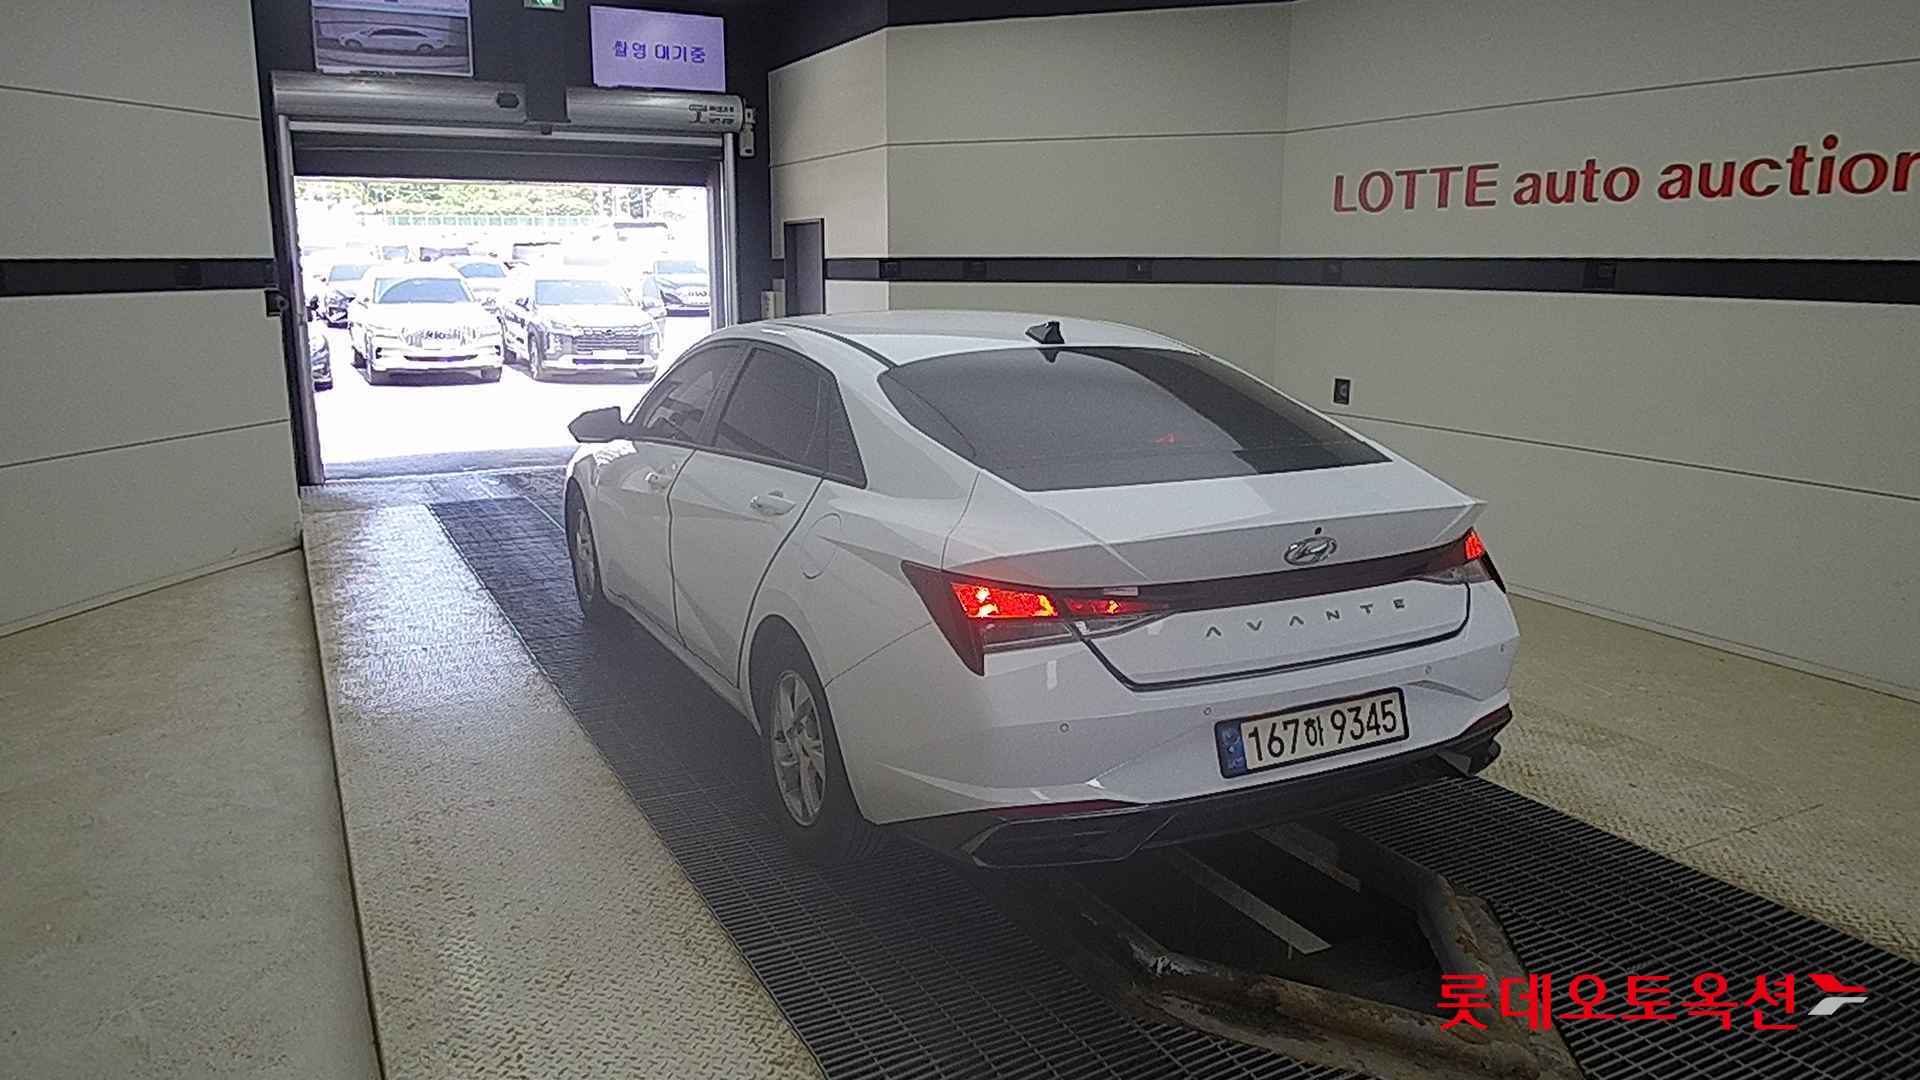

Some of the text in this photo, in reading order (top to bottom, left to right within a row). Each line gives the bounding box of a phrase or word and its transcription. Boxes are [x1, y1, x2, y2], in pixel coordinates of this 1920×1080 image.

[614, 40, 706, 64] 촬영 대기중
[1334, 163, 1499, 213] LOTTE
[1513, 159, 1640, 205] auto
[1206, 599, 1405, 637] AVANTE
[1330, 699, 1397, 744] 9345
